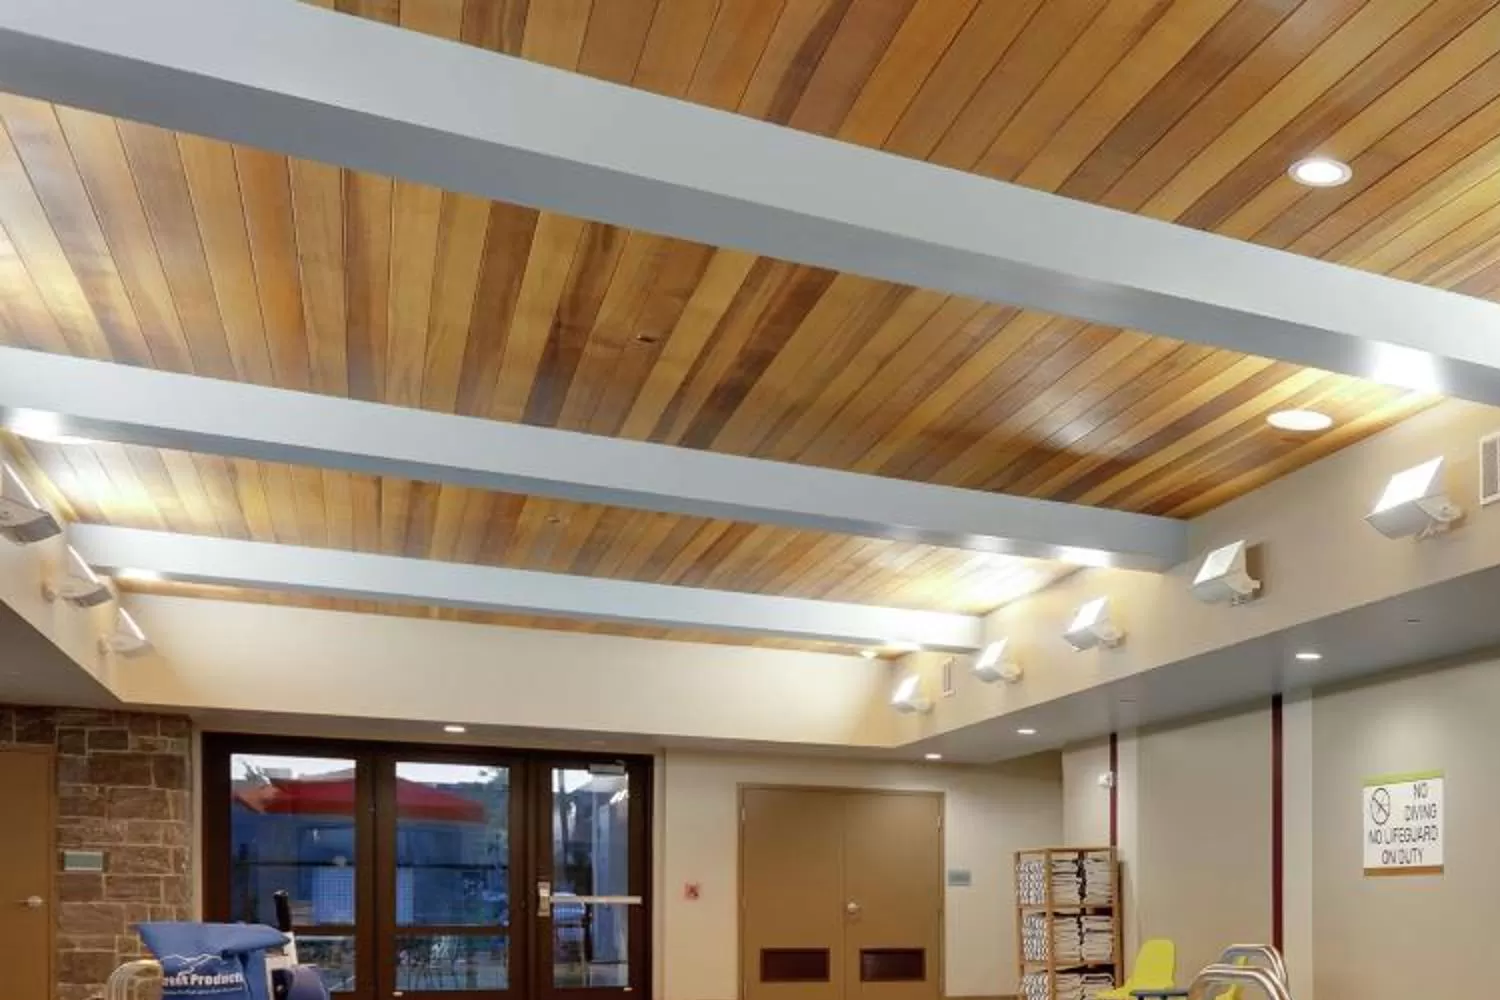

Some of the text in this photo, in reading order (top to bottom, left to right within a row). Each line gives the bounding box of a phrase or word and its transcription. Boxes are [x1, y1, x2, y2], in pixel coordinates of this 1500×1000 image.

[1413, 782, 1428, 799] NO
[1405, 803, 1437, 821] DIVING
[1369, 825, 1439, 844] NO LIFEGUARD
[1382, 847, 1424, 865] ON DUTY
